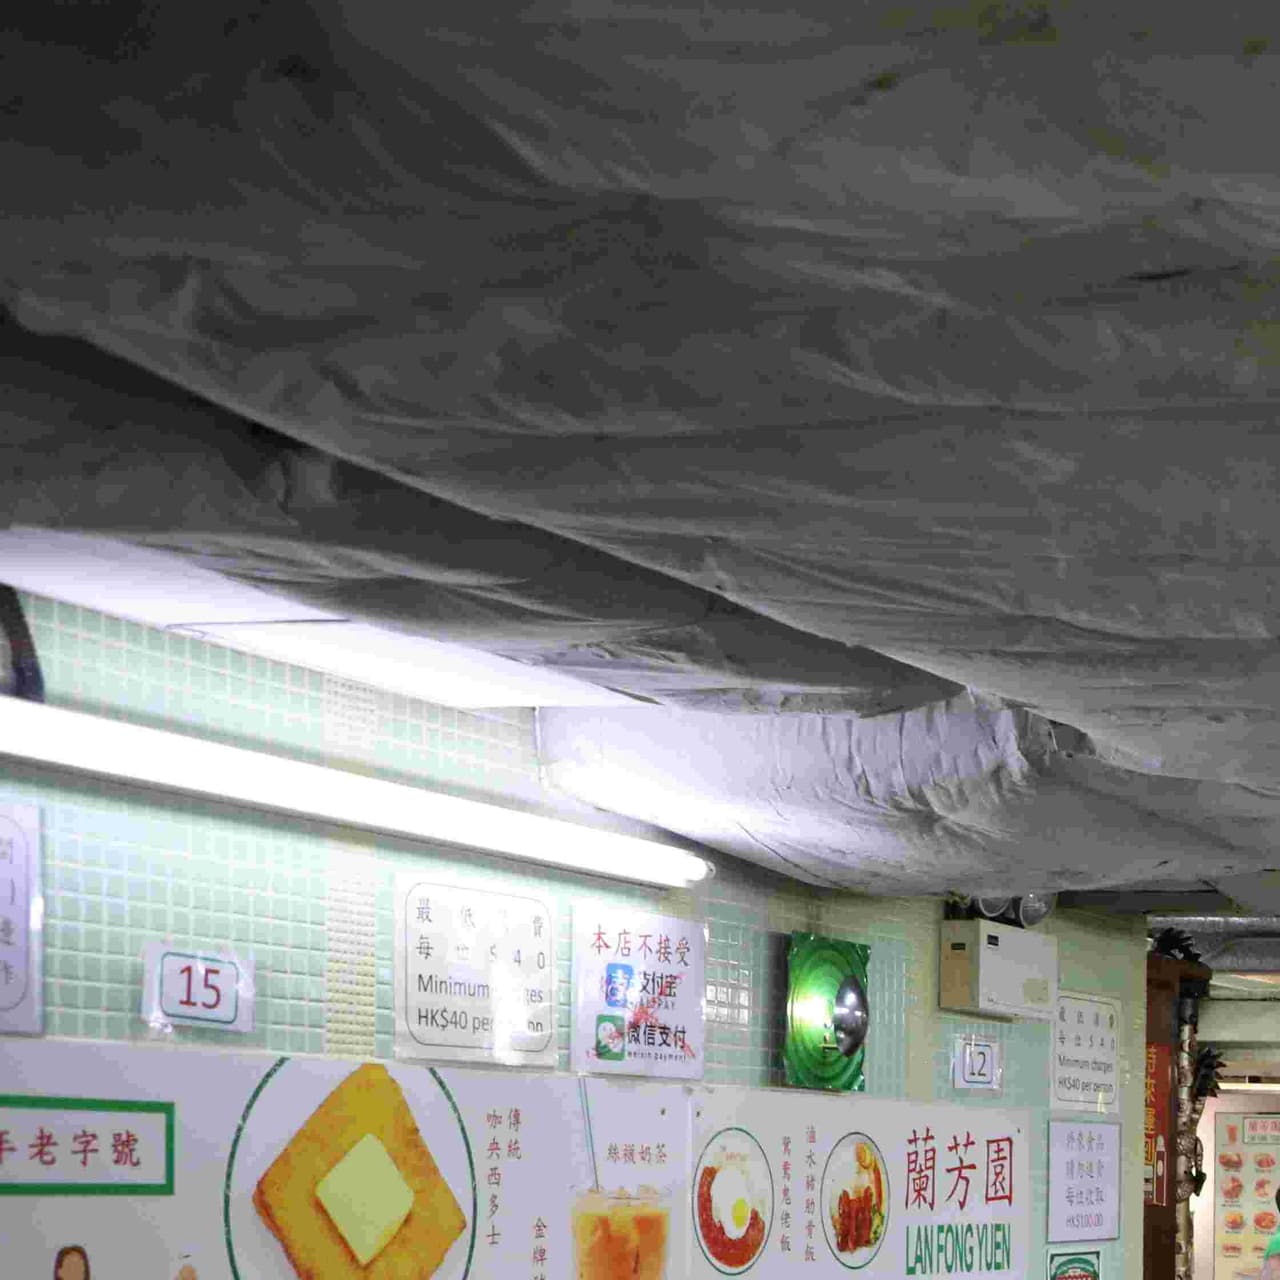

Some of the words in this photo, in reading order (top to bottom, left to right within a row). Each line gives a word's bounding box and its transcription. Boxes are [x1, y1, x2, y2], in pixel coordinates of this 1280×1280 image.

[591, 923, 691, 967] 本店不接受
[179, 965, 221, 1010] 15
[417, 973, 490, 998] Minimum
[417, 1006, 468, 1032] HK$40
[968, 1050, 987, 1078] 12
[606, 1143, 669, 1165] 絲襪奶茶
[904, 1127, 1014, 1212] 蘭芳園
[485, 1109, 504, 1246] 咖央西多士
[905, 1223, 934, 1276] LAN
[936, 1222, 974, 1275] FONG
[977, 1222, 1011, 1273] YUEN
